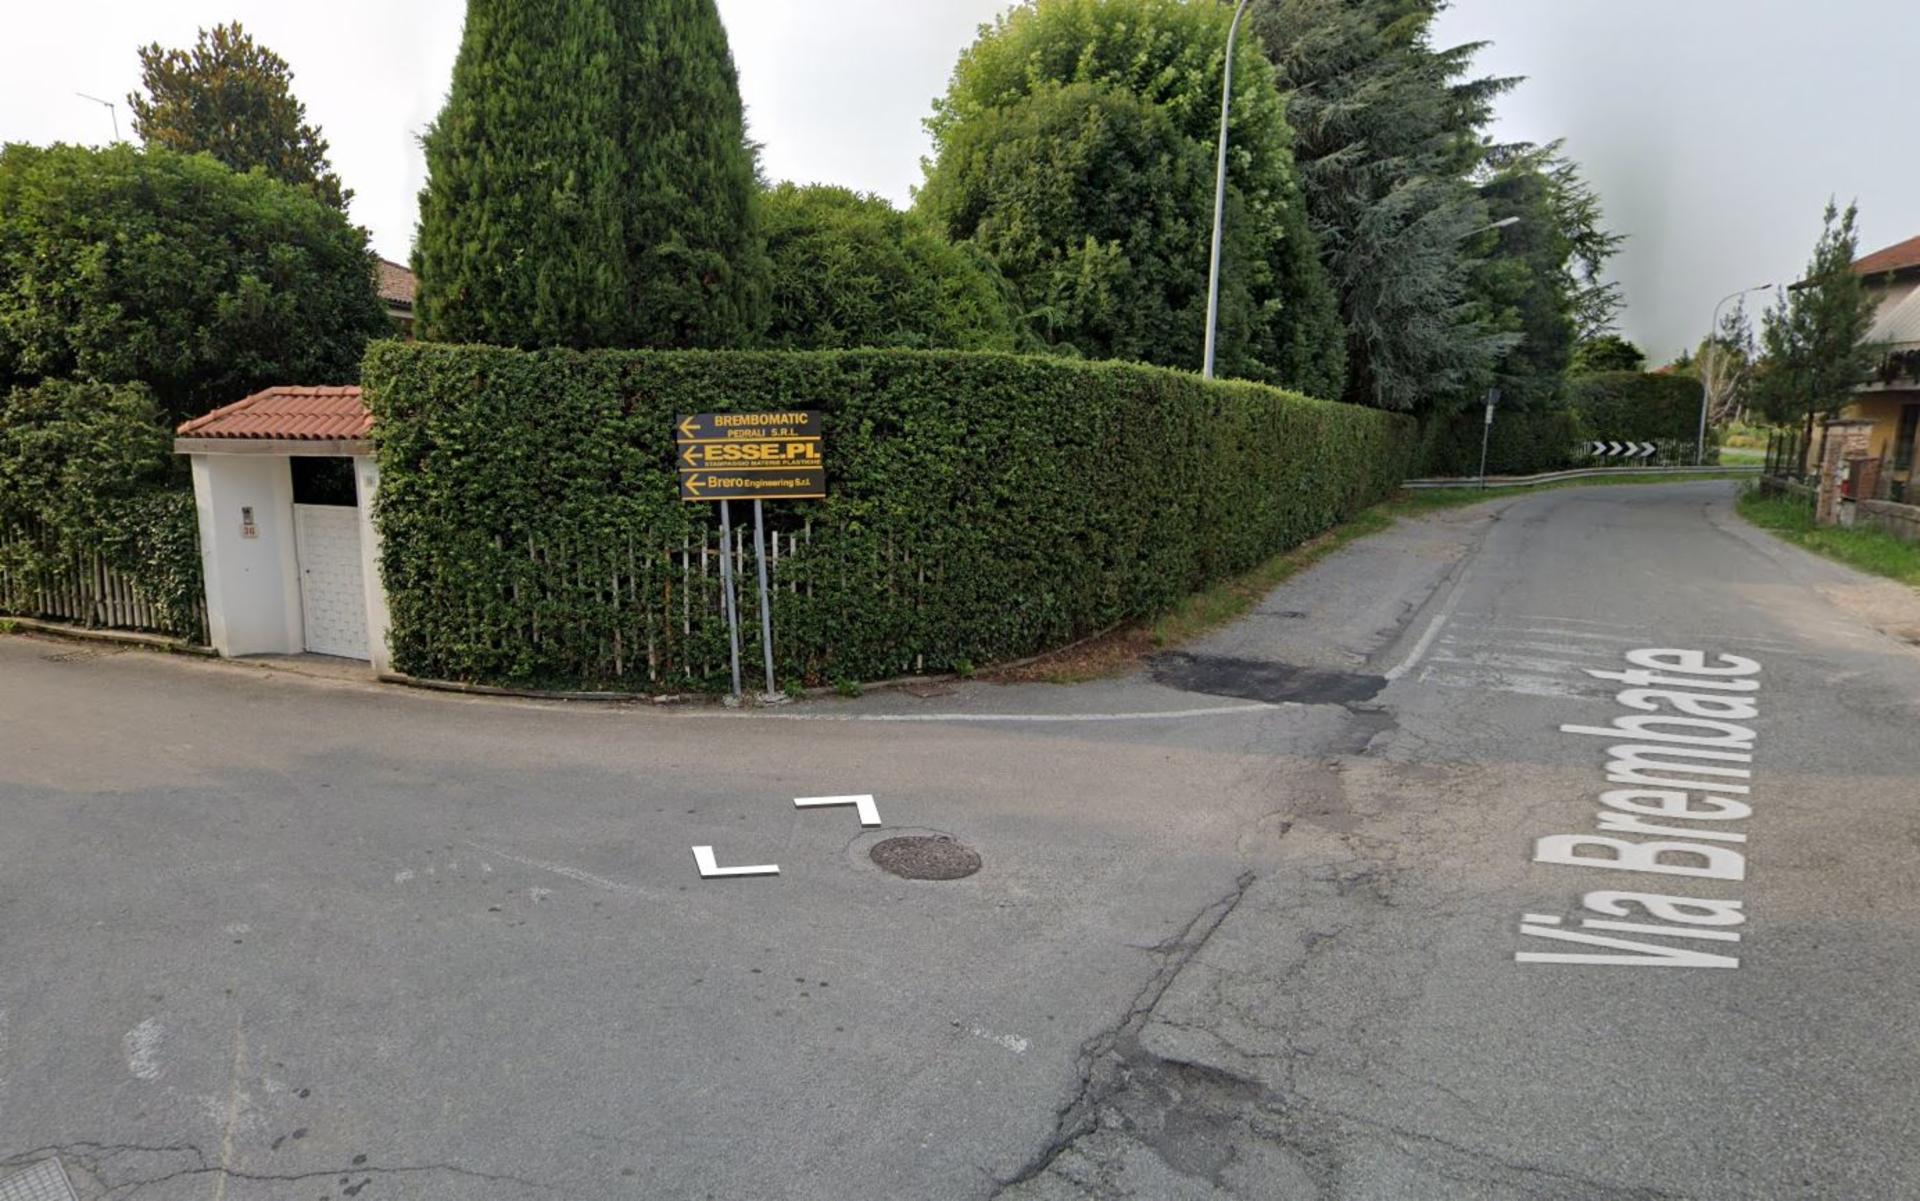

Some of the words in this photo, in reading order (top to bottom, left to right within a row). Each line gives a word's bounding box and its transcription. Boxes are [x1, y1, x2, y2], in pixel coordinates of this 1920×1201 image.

[714, 413, 808, 427] BREMBOMATIC
[727, 429, 766, 438] PEDRALI
[771, 428, 798, 437] S.R.L.
[707, 476, 743, 489] Brero
[744, 478, 794, 489] Engineering
